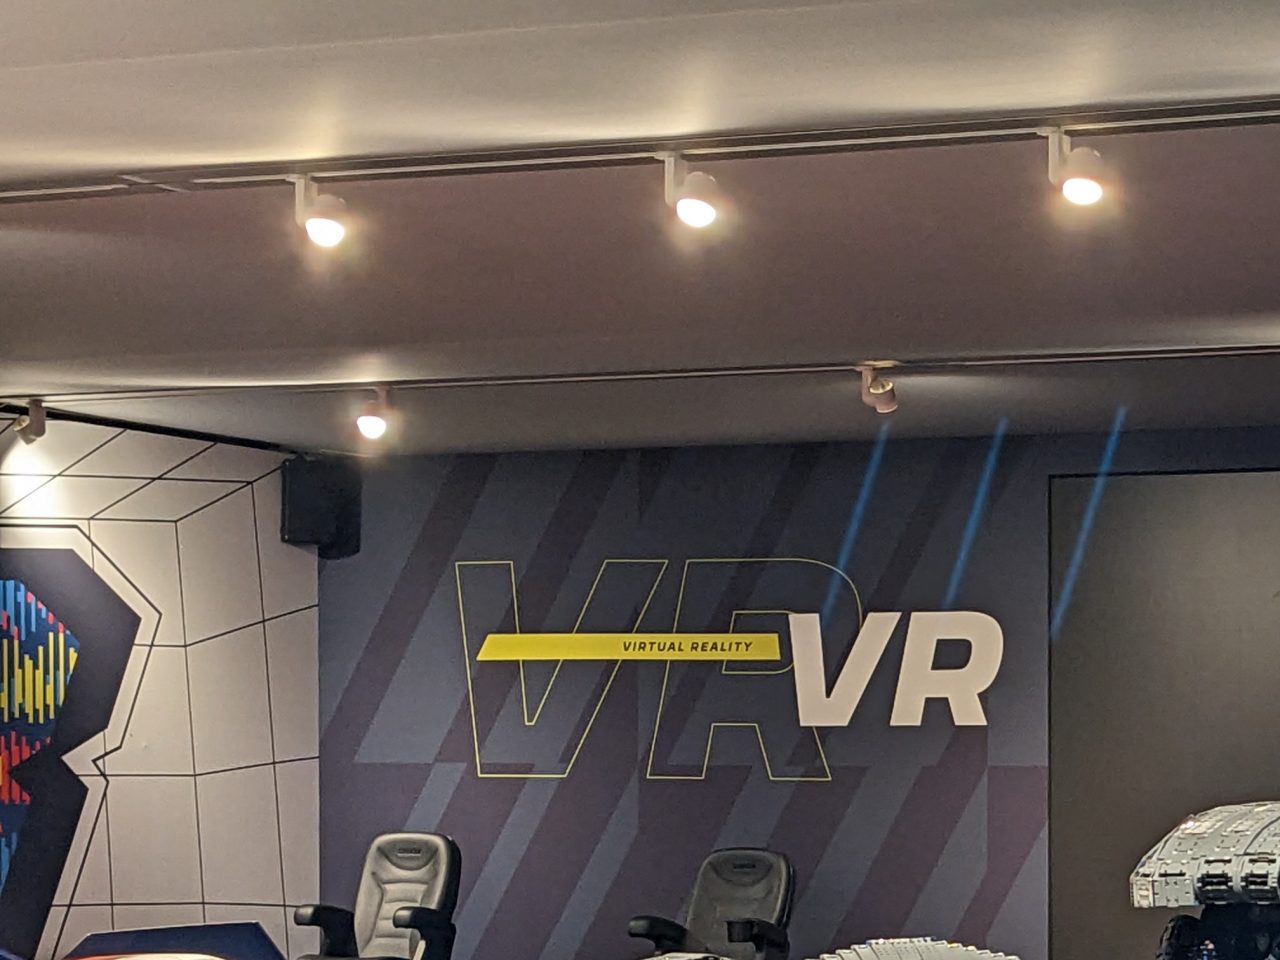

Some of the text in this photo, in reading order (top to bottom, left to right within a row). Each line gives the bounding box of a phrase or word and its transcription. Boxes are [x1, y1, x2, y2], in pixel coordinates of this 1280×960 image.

[623, 640, 753, 652] VIRTUAL REALITY
[787, 610, 1005, 727] VR
